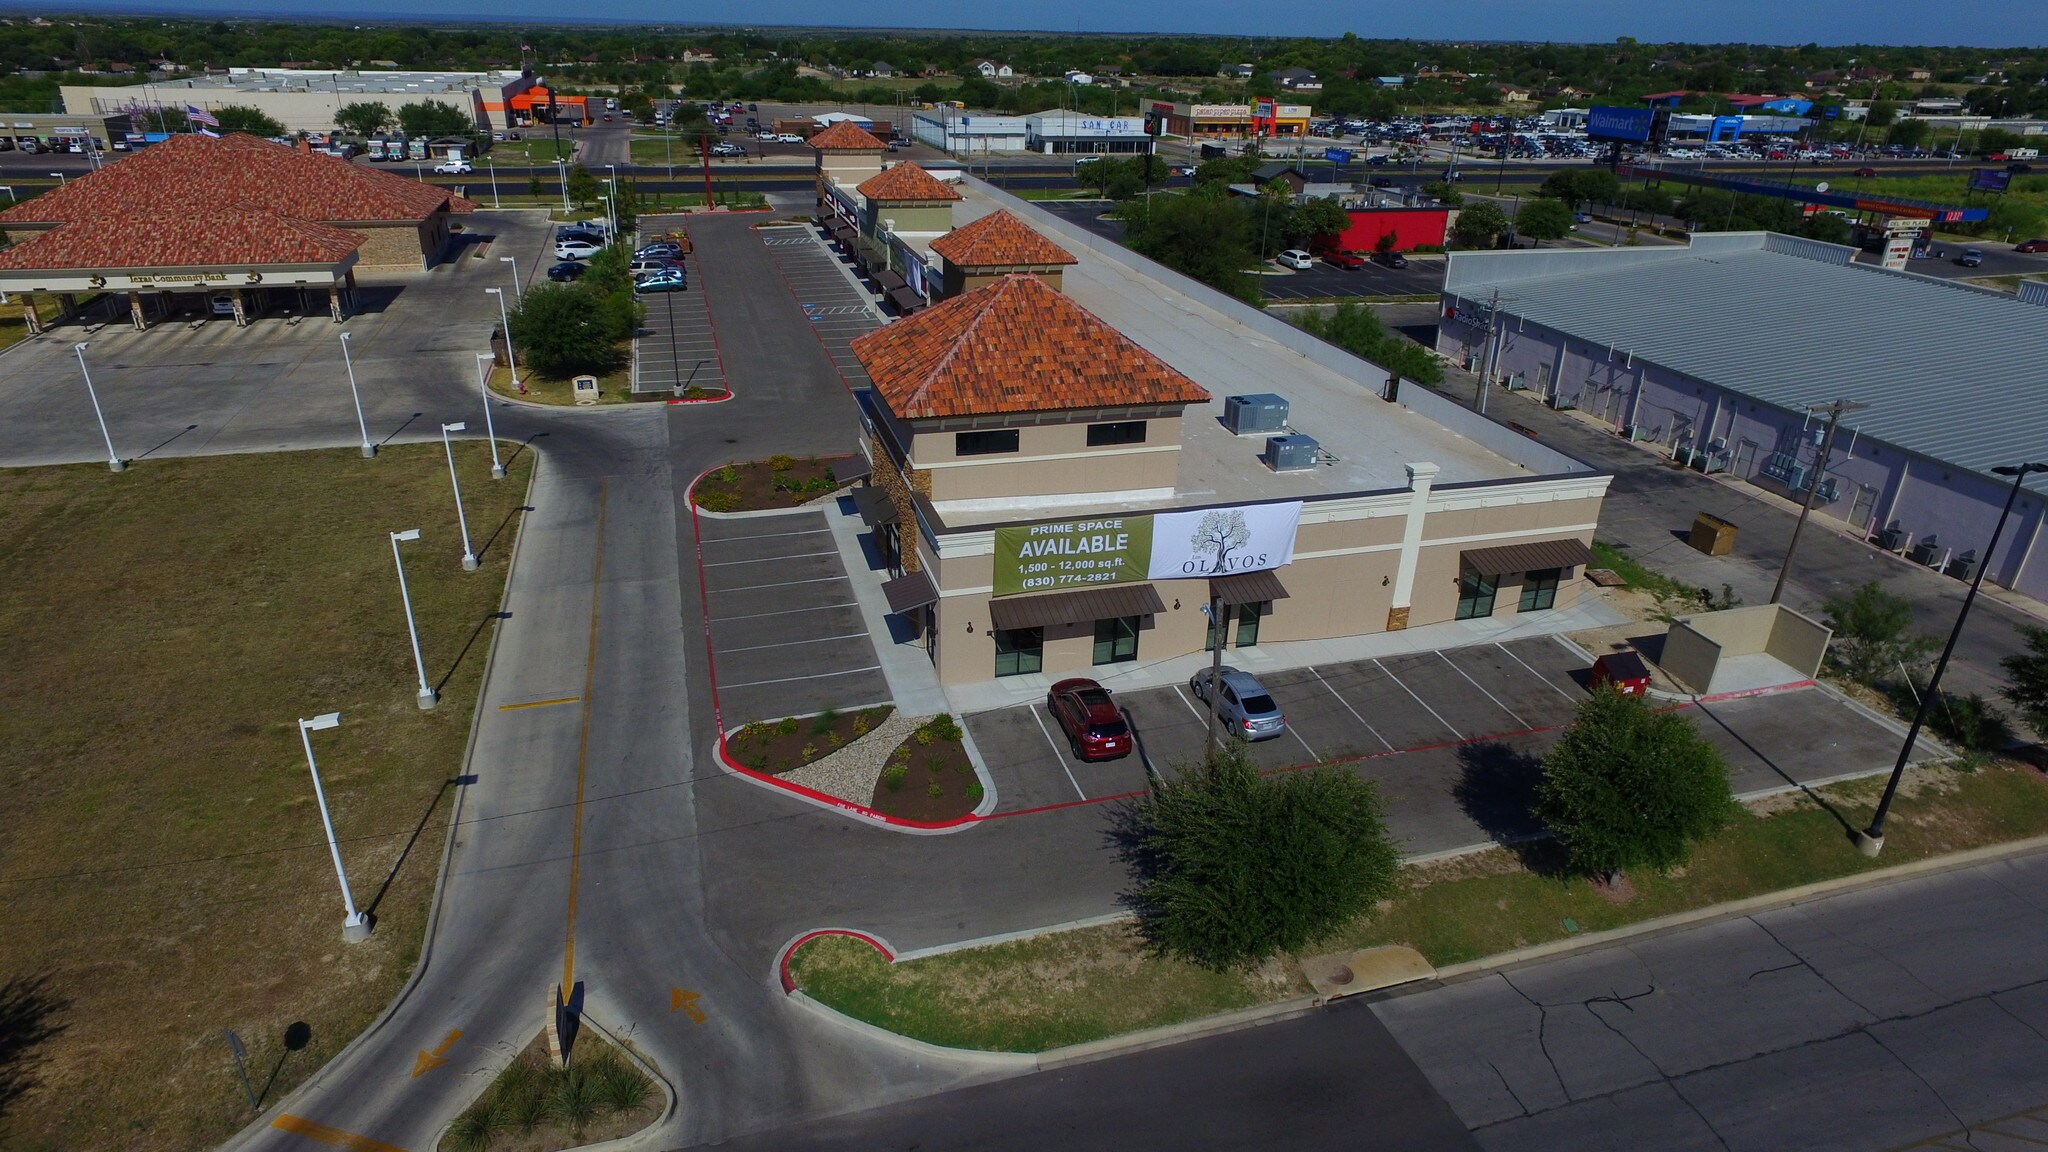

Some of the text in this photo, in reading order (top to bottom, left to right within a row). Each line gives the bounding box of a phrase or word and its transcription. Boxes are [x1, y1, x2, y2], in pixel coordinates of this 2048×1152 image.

[1082, 120, 1129, 130] SAN CAR
[1590, 112, 1634, 130] Walmart
[127, 271, 228, 285] Texas Community Bank
[1030, 520, 1123, 536] PRIME SPACE
[1018, 533, 1129, 558] AVAILABLE
[1018, 562, 1048, 575] 1,500
[1059, 560, 1095, 571] 12,000
[1098, 557, 1126, 569] sq.ft.
[1022, 572, 1117, 590] (830) 774-2821
